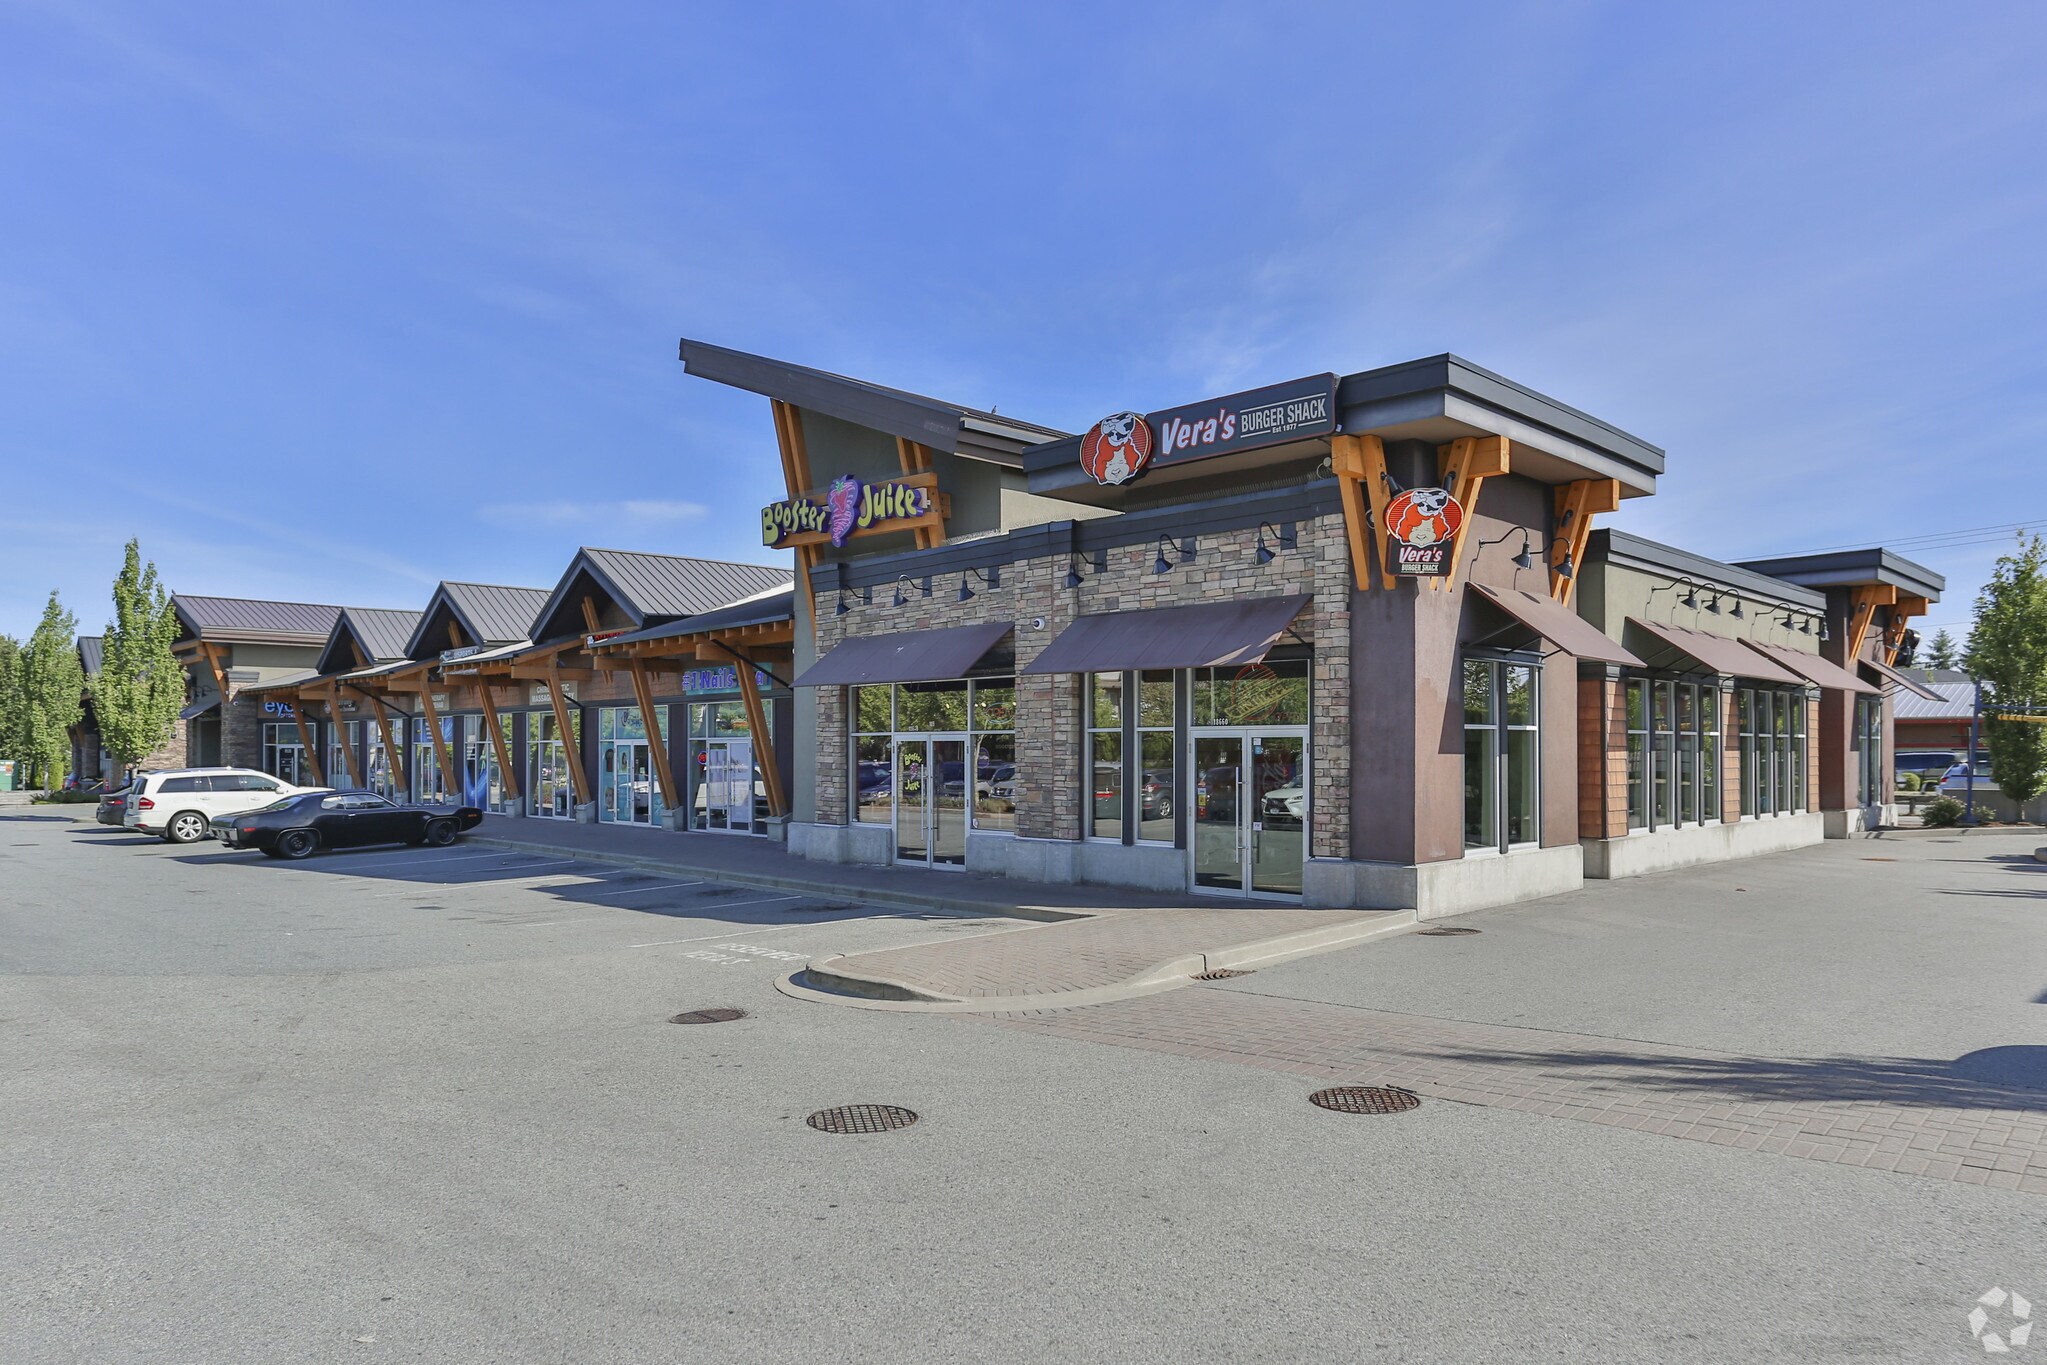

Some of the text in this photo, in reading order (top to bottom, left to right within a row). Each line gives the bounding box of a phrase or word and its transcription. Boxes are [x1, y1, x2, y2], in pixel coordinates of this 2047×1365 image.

[1241, 398, 1327, 433] BURGER SHACK
[1160, 408, 1236, 457] Vera's
[1272, 423, 1298, 434] Est 1977
[761, 483, 920, 546] Booster Juice
[1398, 546, 1443, 563] Vera's
[1401, 564, 1438, 572] BURGER SHACK
[682, 671, 697, 691] #1
[701, 668, 734, 689] Nails
